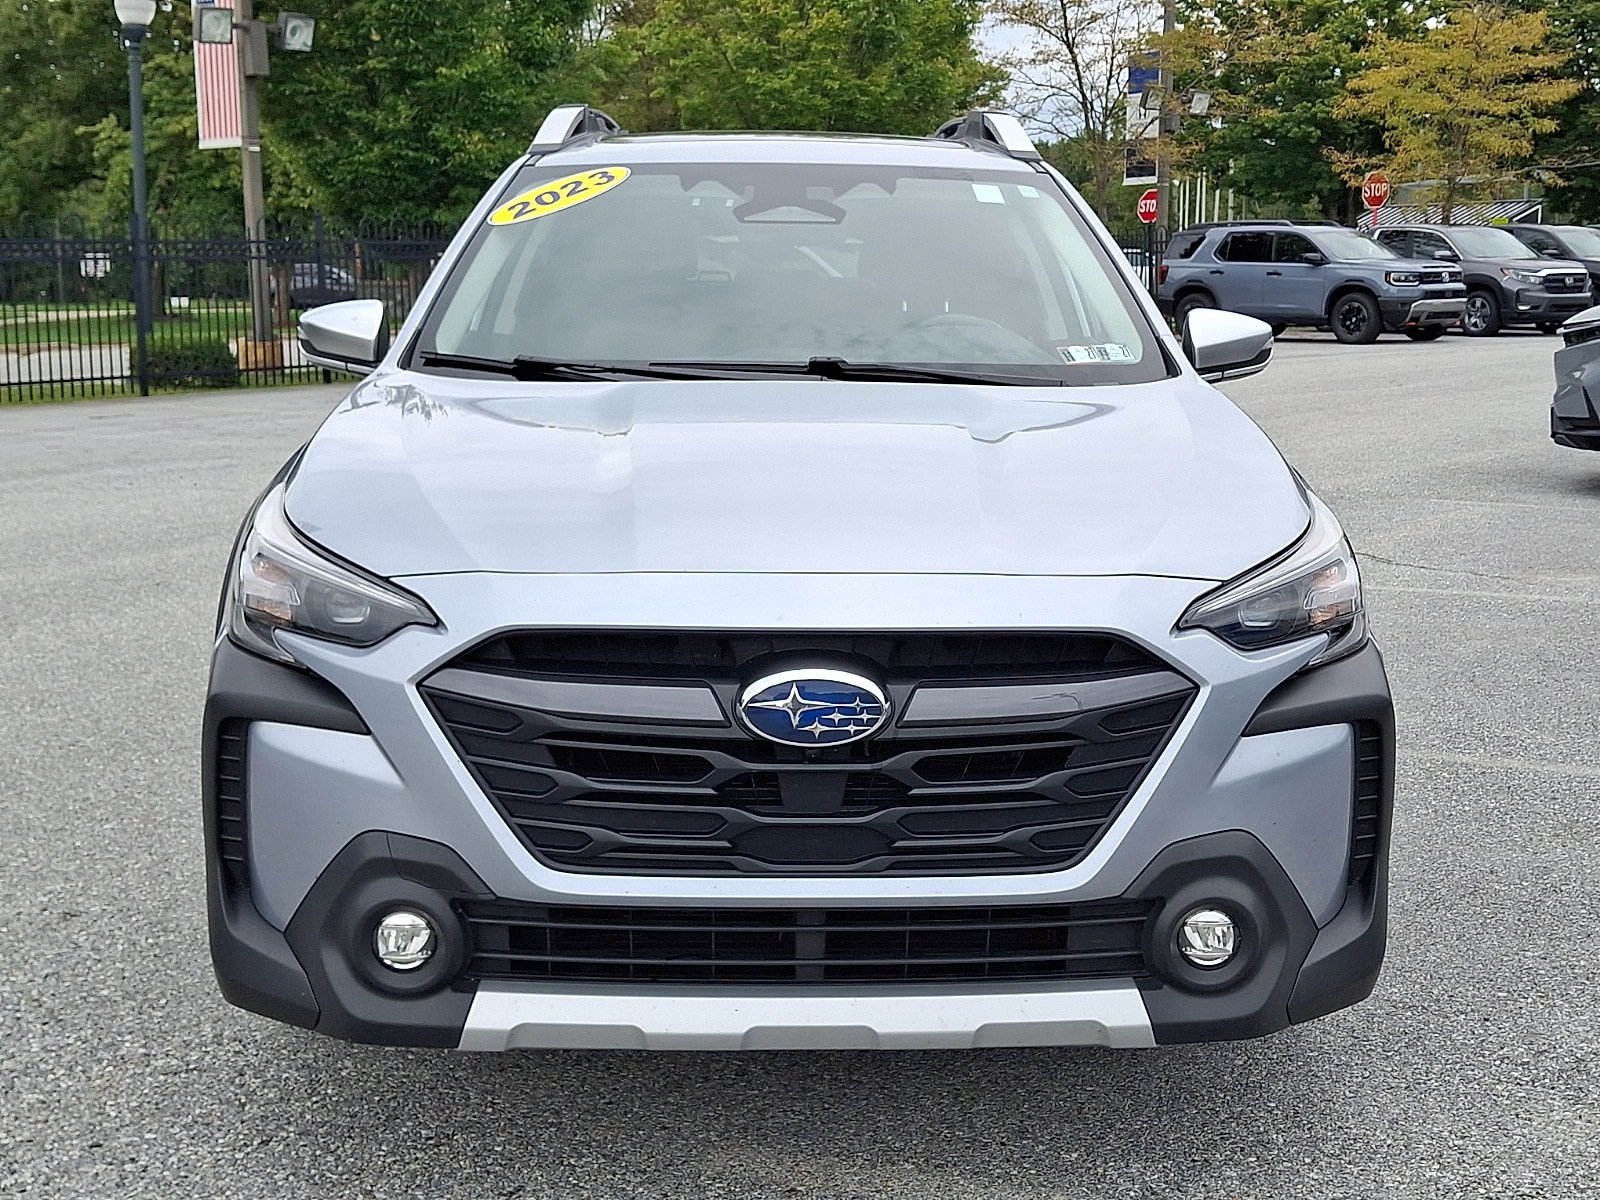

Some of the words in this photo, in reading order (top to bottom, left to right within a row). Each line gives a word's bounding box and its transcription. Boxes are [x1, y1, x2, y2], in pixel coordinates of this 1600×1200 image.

[508, 171, 615, 220] 2023
[1364, 182, 1388, 198] STOP
[1140, 199, 1157, 213] STO
